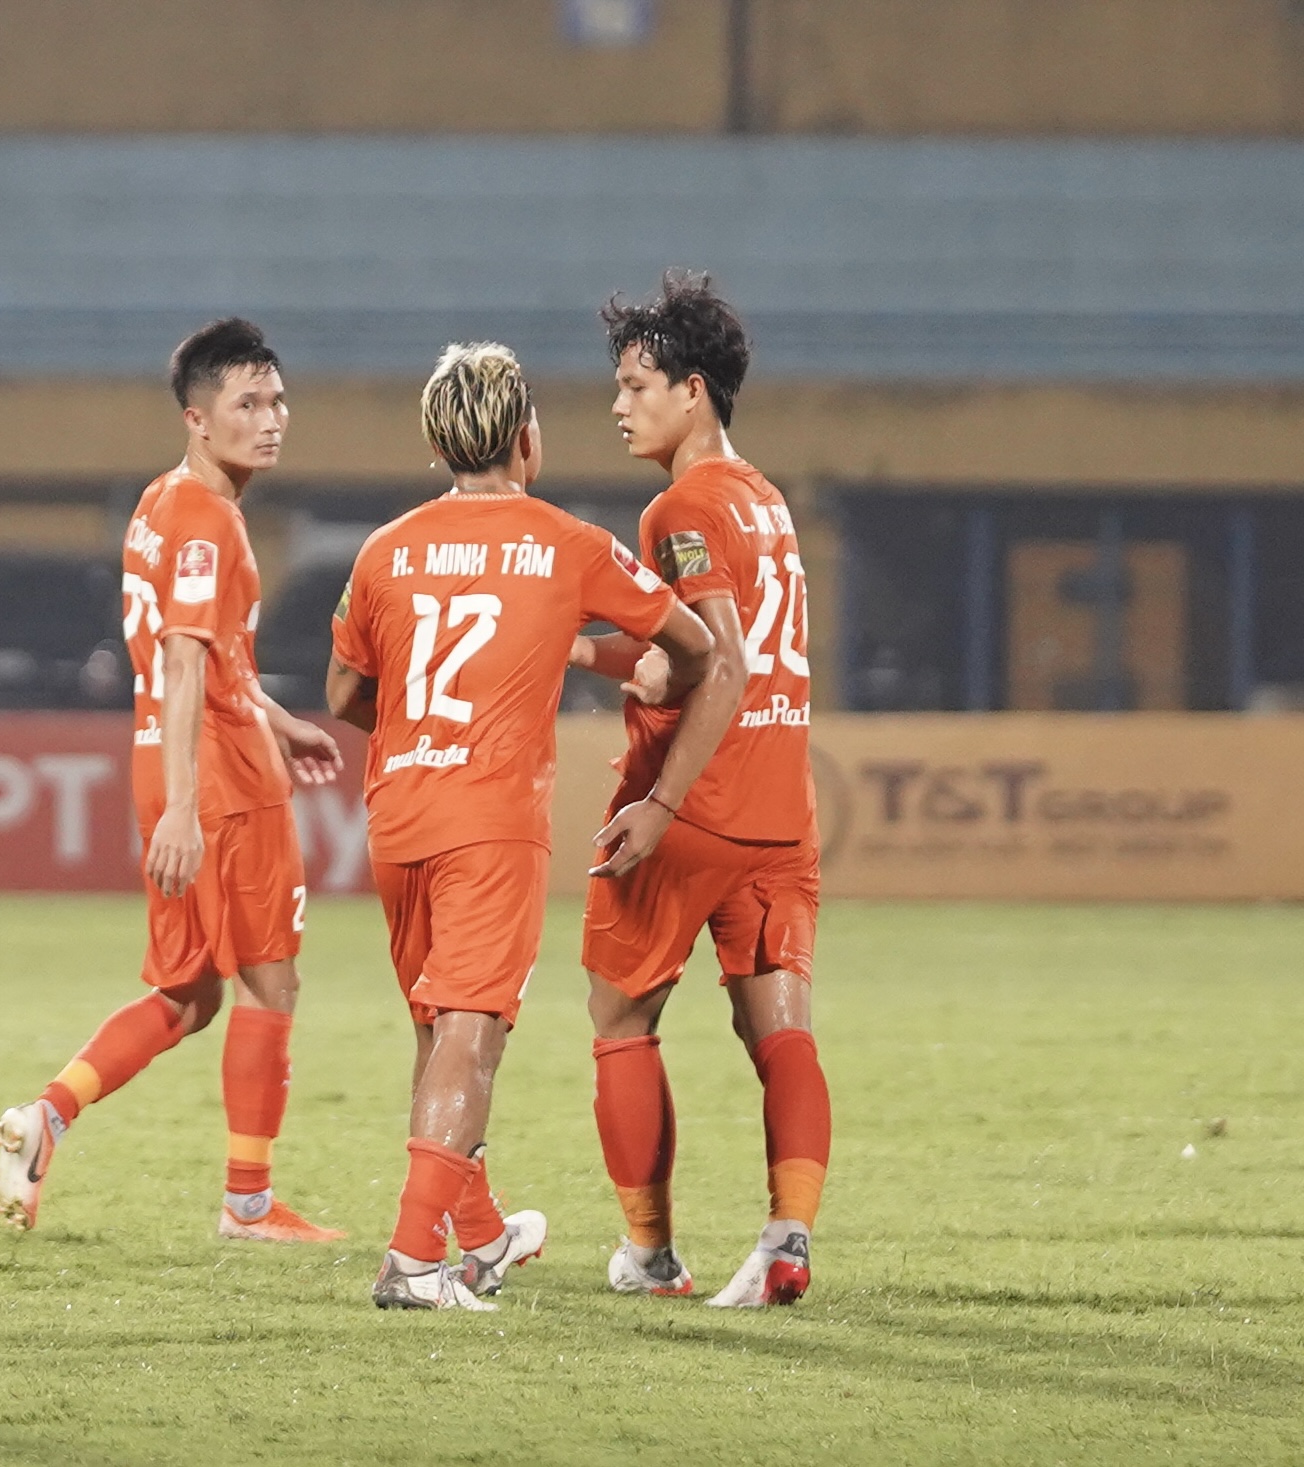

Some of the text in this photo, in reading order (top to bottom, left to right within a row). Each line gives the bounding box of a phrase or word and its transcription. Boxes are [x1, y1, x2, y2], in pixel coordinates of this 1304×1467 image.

[424, 543, 488, 576] MINH
[500, 533, 556, 578] TÂM
[742, 551, 810, 677] 20
[405, 593, 503, 724] 12
[738, 693, 810, 727] muRat
